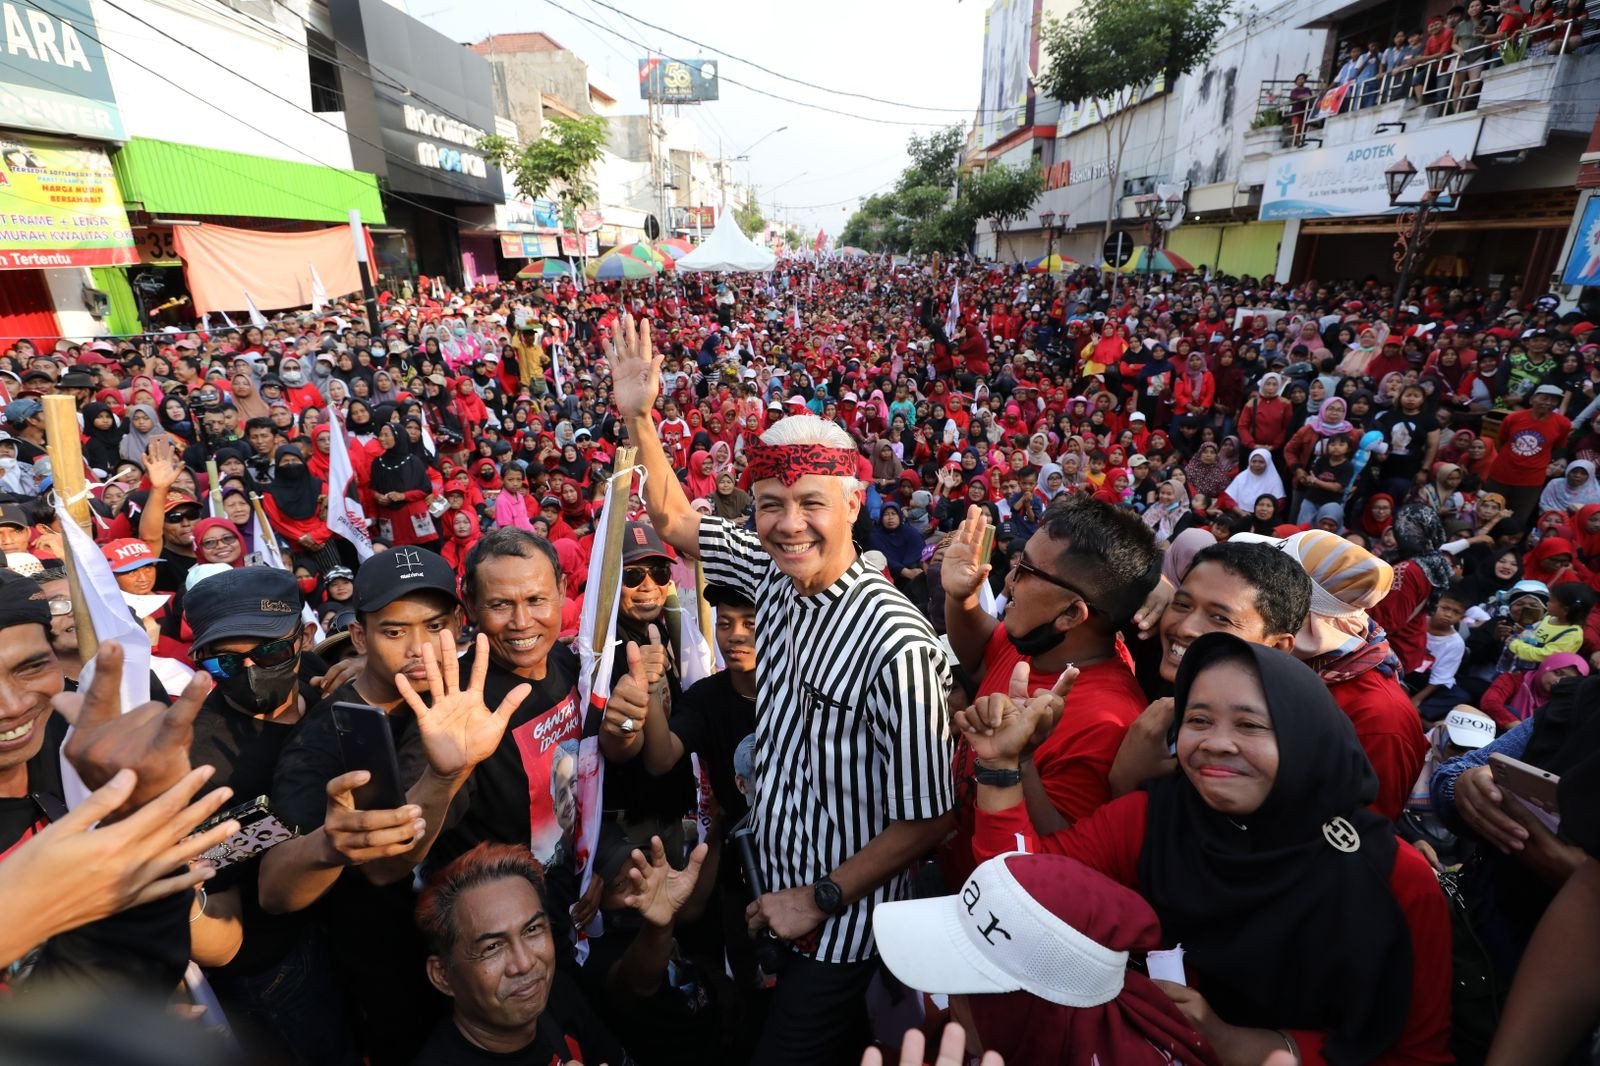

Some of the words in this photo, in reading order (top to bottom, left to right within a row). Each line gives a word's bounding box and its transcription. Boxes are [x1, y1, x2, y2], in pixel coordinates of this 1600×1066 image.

[1346, 143, 1396, 163] APOTEK
[12, 216, 54, 226] FRAME
[74, 216, 109, 227] LENSA
[10, 252, 72, 265] Tertentu
[1450, 715, 1494, 733] SPOR
